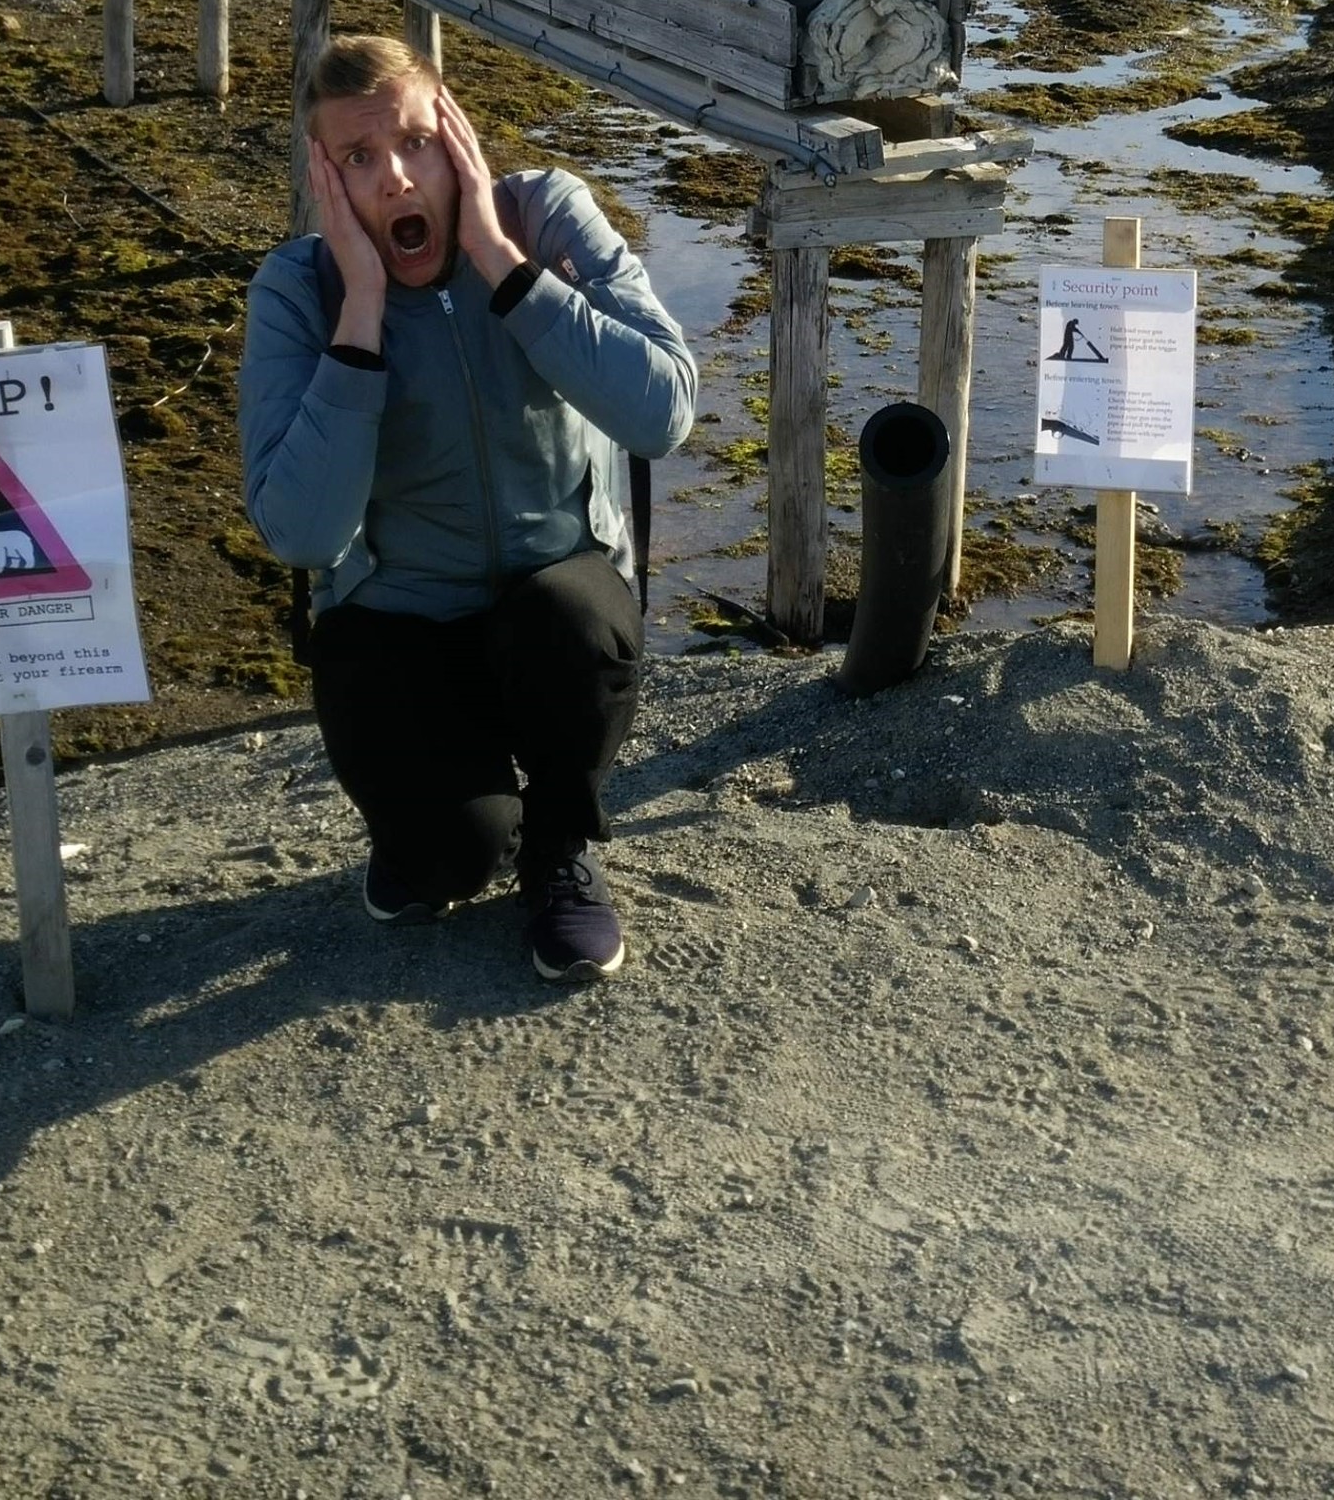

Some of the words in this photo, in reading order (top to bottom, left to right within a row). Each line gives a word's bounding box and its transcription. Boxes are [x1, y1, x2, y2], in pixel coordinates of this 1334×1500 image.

[1062, 279, 1119, 298] Security
[1122, 283, 1159, 299] point
[1045, 299, 1071, 309] Before
[1071, 300, 1099, 311] leaving
[1044, 373, 1068, 382] Before
[1068, 375, 1100, 385] entering
[18, 603, 75, 618] DANGER
[9, 649, 66, 665] beyond
[74, 646, 110, 660] this
[13, 668, 50, 684] your
[59, 662, 124, 678] firearm
